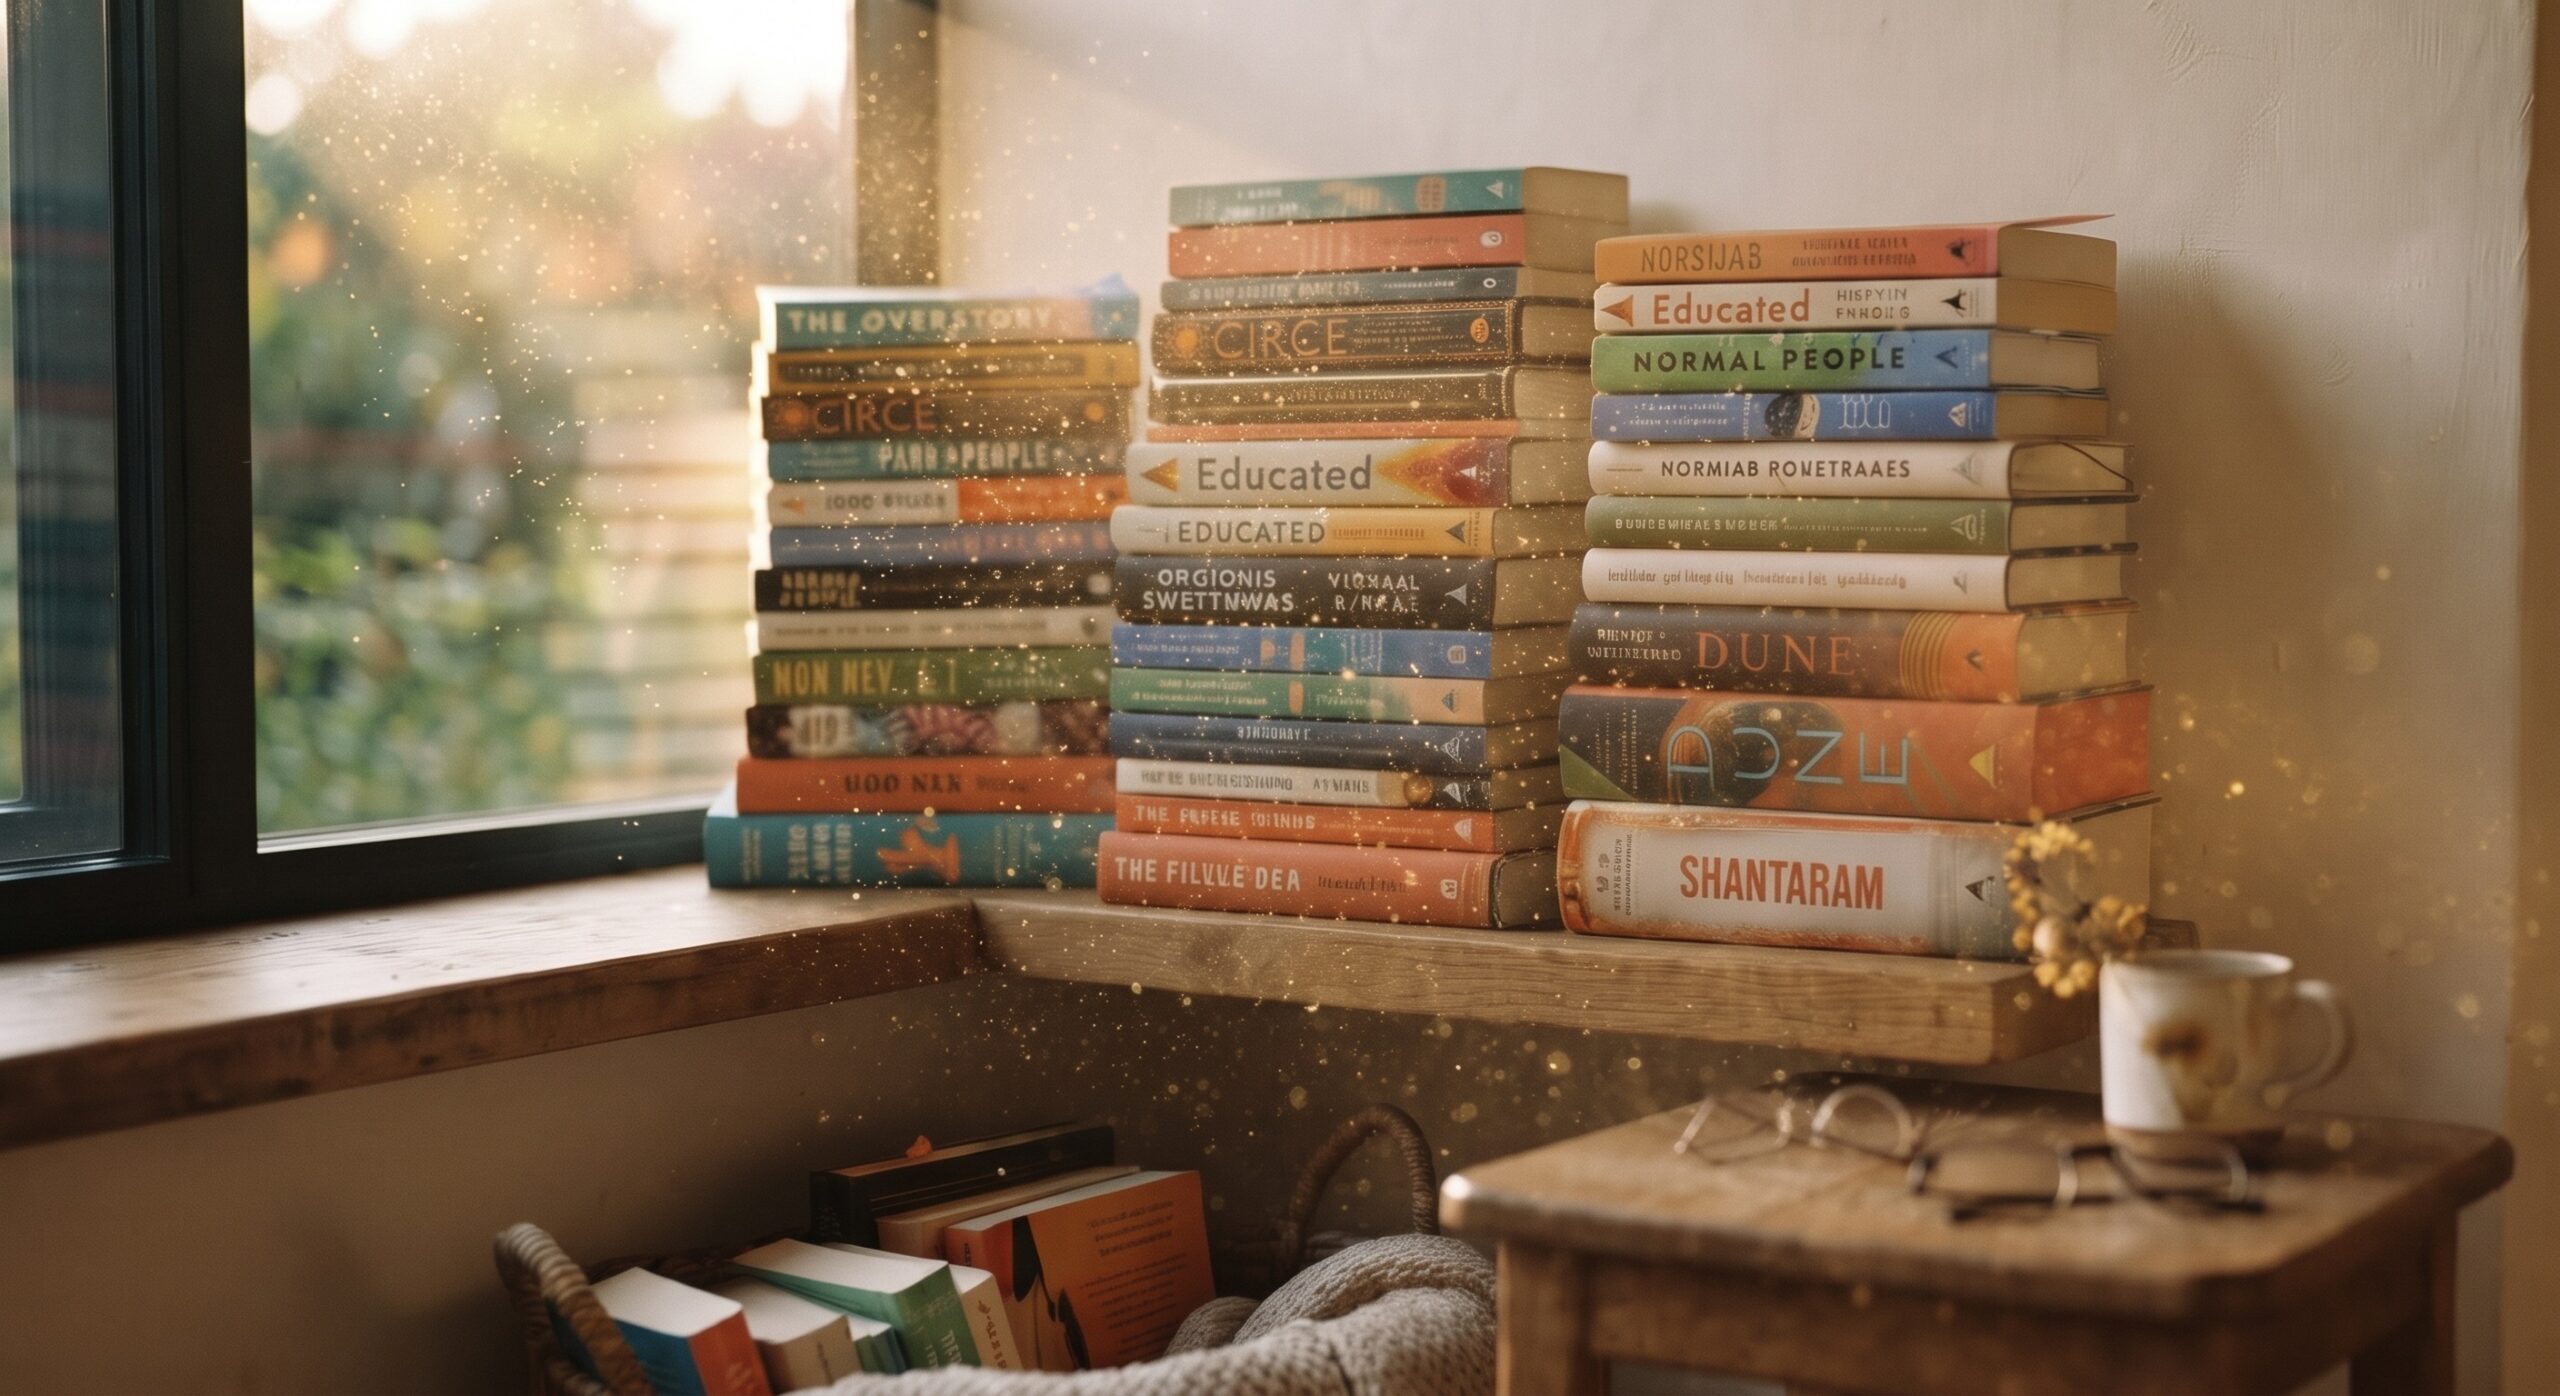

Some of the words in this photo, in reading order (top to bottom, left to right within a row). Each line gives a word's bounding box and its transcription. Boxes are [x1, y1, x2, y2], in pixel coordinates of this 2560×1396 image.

[786, 309, 848, 335] THE
[861, 307, 1054, 333] OVERSTORY
[1652, 288, 1810, 325] Educated
[1214, 318, 1349, 359] CIRCE
[1633, 349, 1768, 373] NORMAL
[1781, 346, 1906, 372] PEOPLE
[811, 399, 939, 434] CIRCE
[1196, 454, 1372, 491] Educated
[1177, 520, 1326, 545] EDUCATED
[1157, 568, 1276, 589] ORGIONIS
[1695, 631, 1857, 678] DUNE
[1135, 804, 1170, 823] THE
[1114, 857, 1157, 883] THE
[1255, 866, 1301, 892] DEA
[1679, 854, 1885, 911] SHANTARAM
